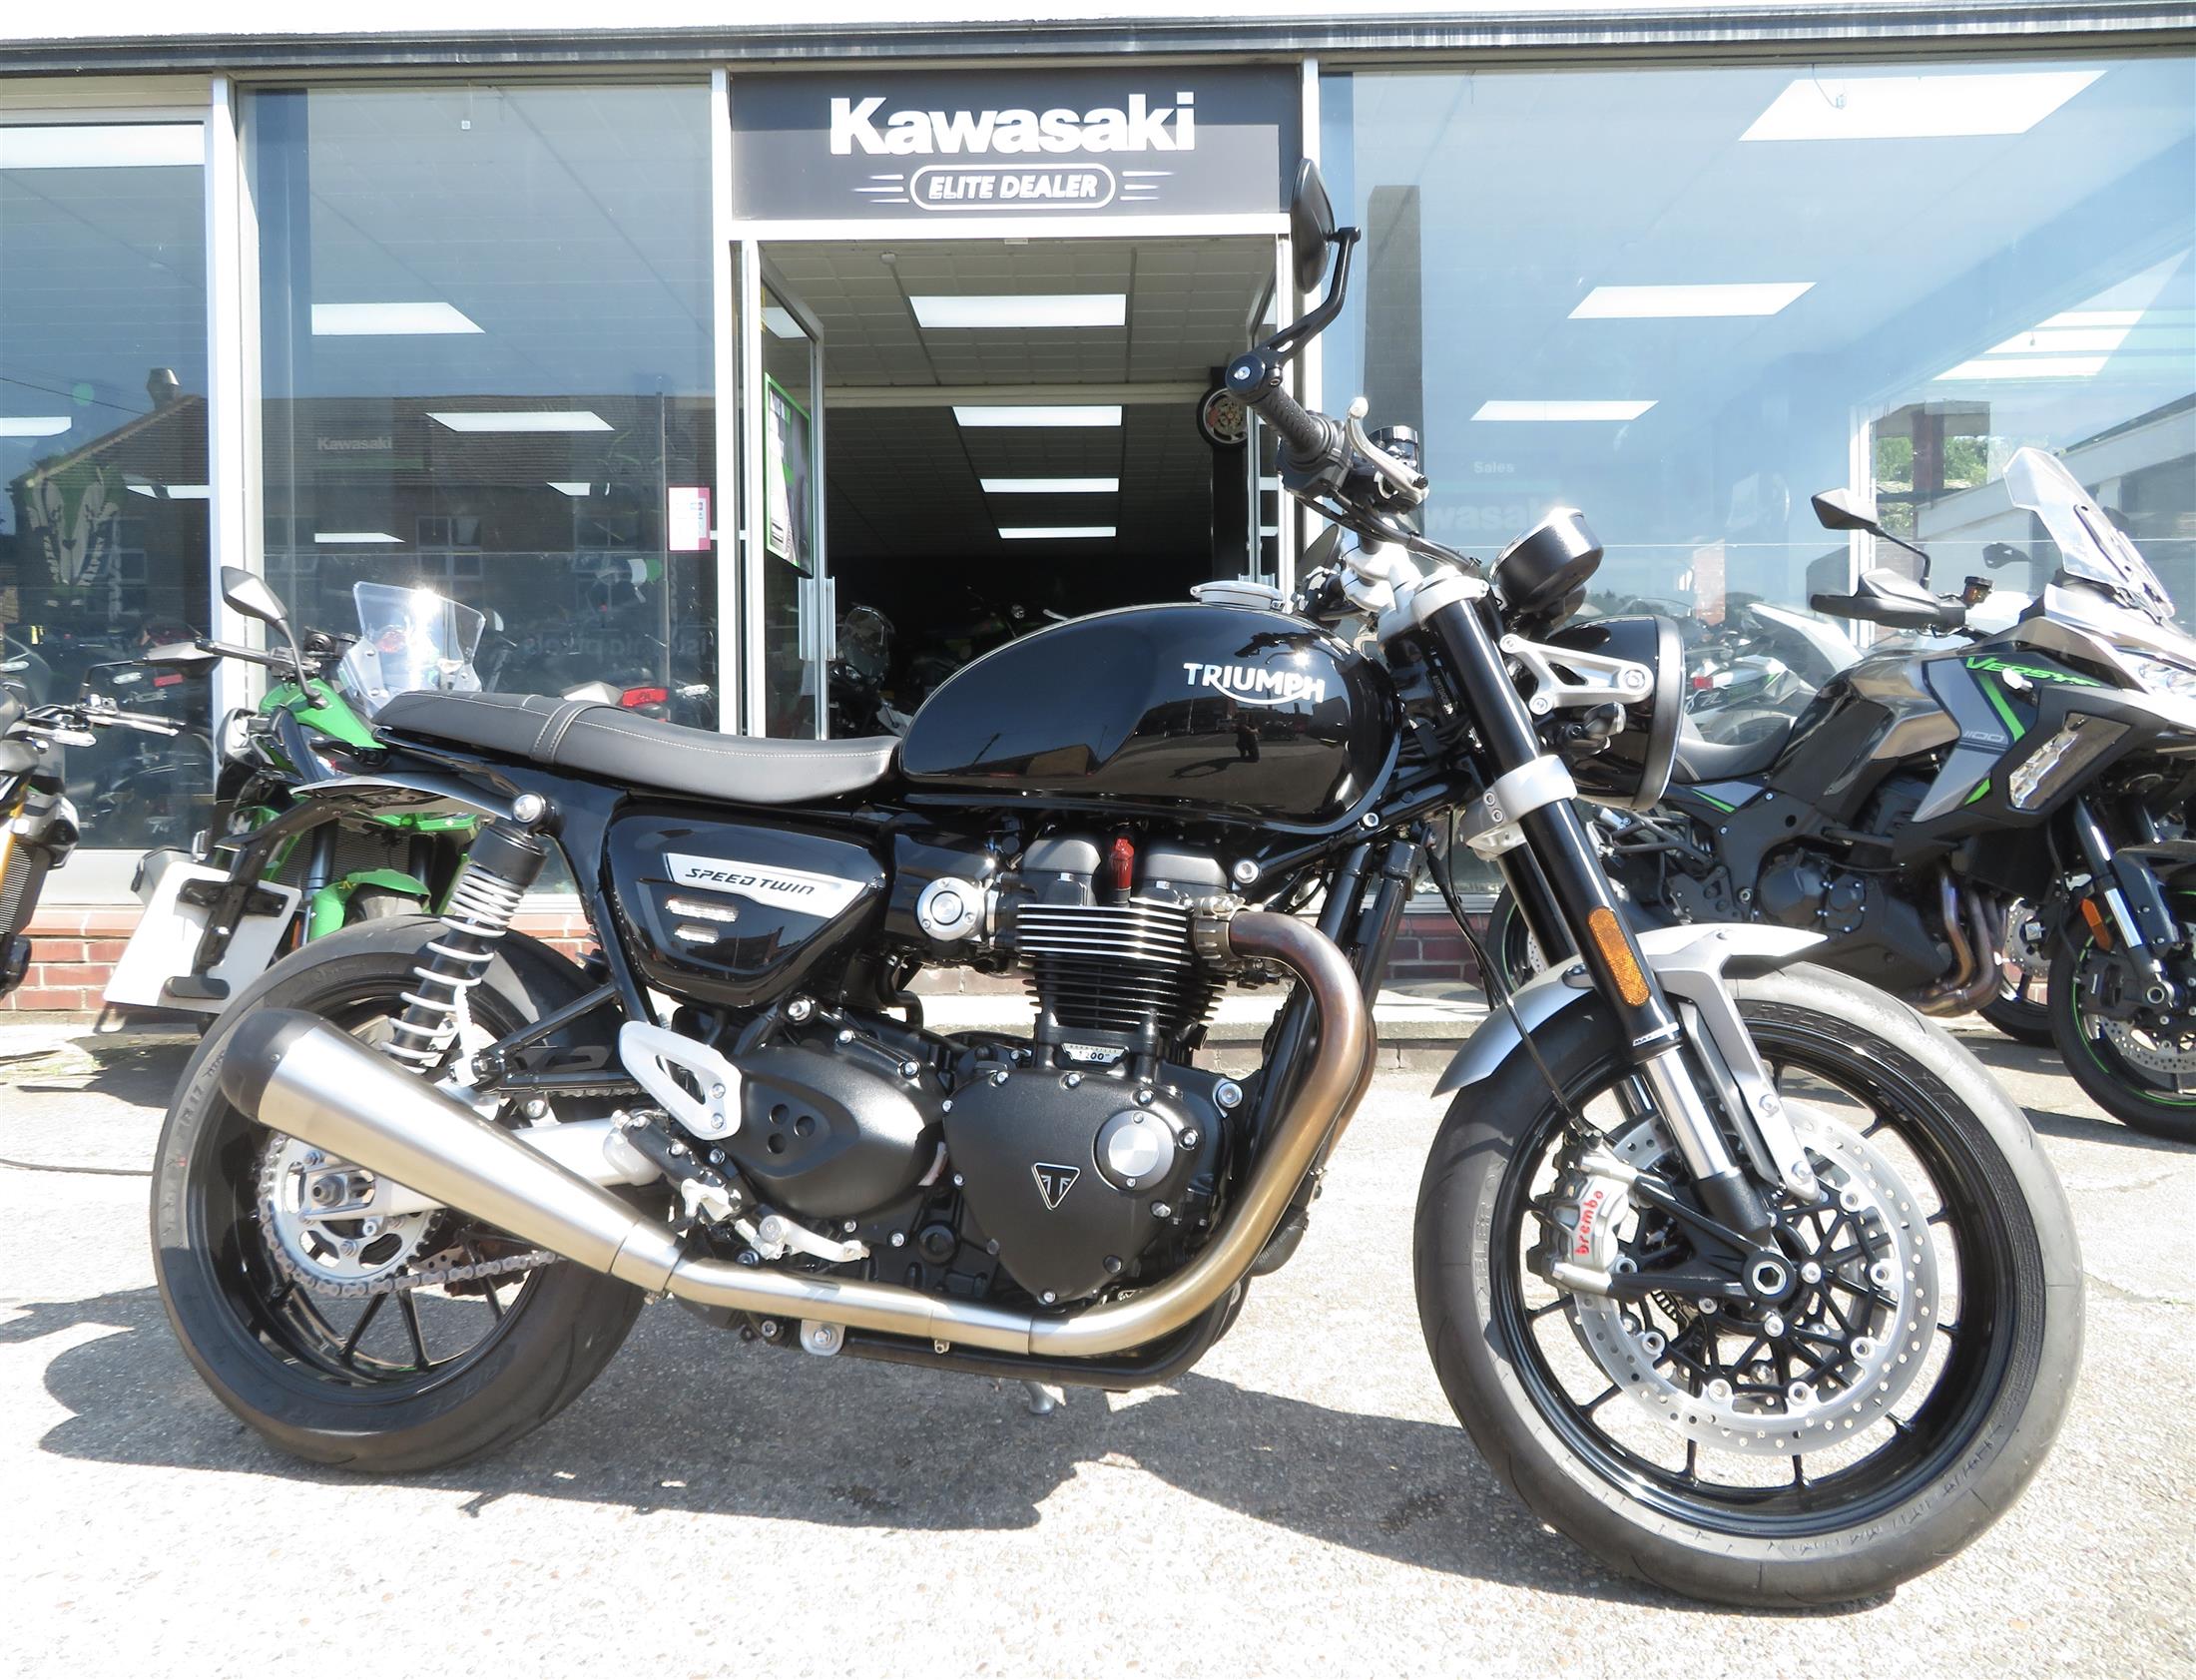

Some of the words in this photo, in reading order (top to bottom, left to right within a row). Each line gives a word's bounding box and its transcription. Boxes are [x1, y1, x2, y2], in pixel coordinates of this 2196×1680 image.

[830, 92, 1195, 155] Kawasaki
[928, 175, 996, 200] ELITE
[999, 174, 1097, 199] DEALER
[1473, 461, 1515, 474] Sales
[1183, 663, 1326, 704] TRIUMPH
[685, 867, 757, 886] SPEED
[760, 878, 815, 895] TWIN
[1574, 1190, 1604, 1255] brembo
